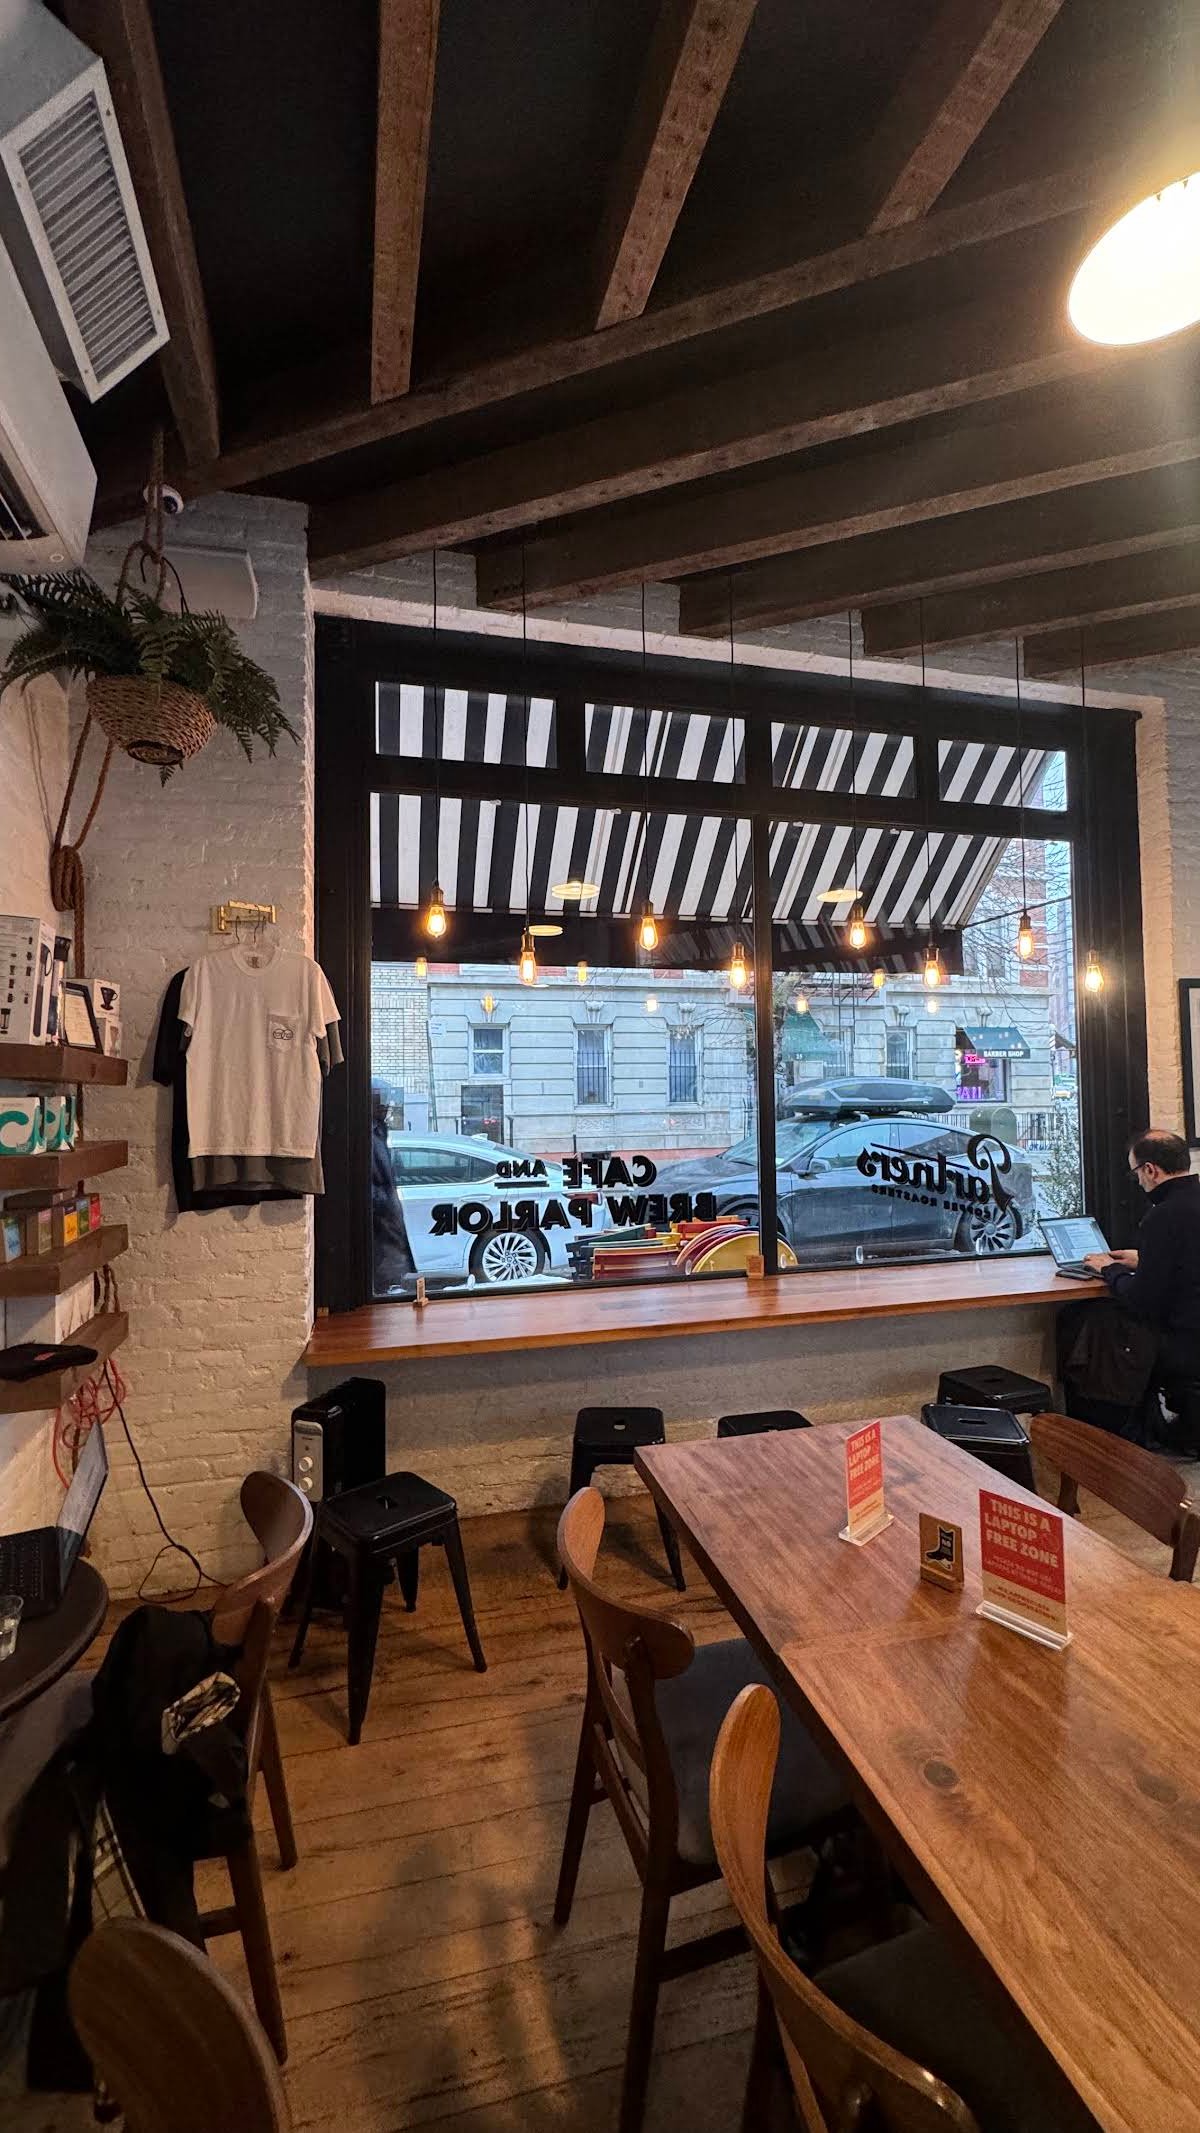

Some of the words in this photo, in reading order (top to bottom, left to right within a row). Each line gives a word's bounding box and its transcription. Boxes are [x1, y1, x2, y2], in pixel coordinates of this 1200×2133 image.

[983, 1050, 1007, 1058] BARBER
[848, 1444, 872, 1468] LAPTOP
[851, 1434, 865, 1452] THIS
[849, 1463, 864, 1481] FREE
[864, 1453, 880, 1472] ZONE
[984, 1512, 1038, 1541] LAPTOP
[990, 1499, 1021, 1520] THIS
[1023, 1510, 1038, 1527] IS
[1040, 1517, 1052, 1533] A
[985, 1529, 1018, 1552] FREE
[1020, 1542, 1059, 1568] ZONE
